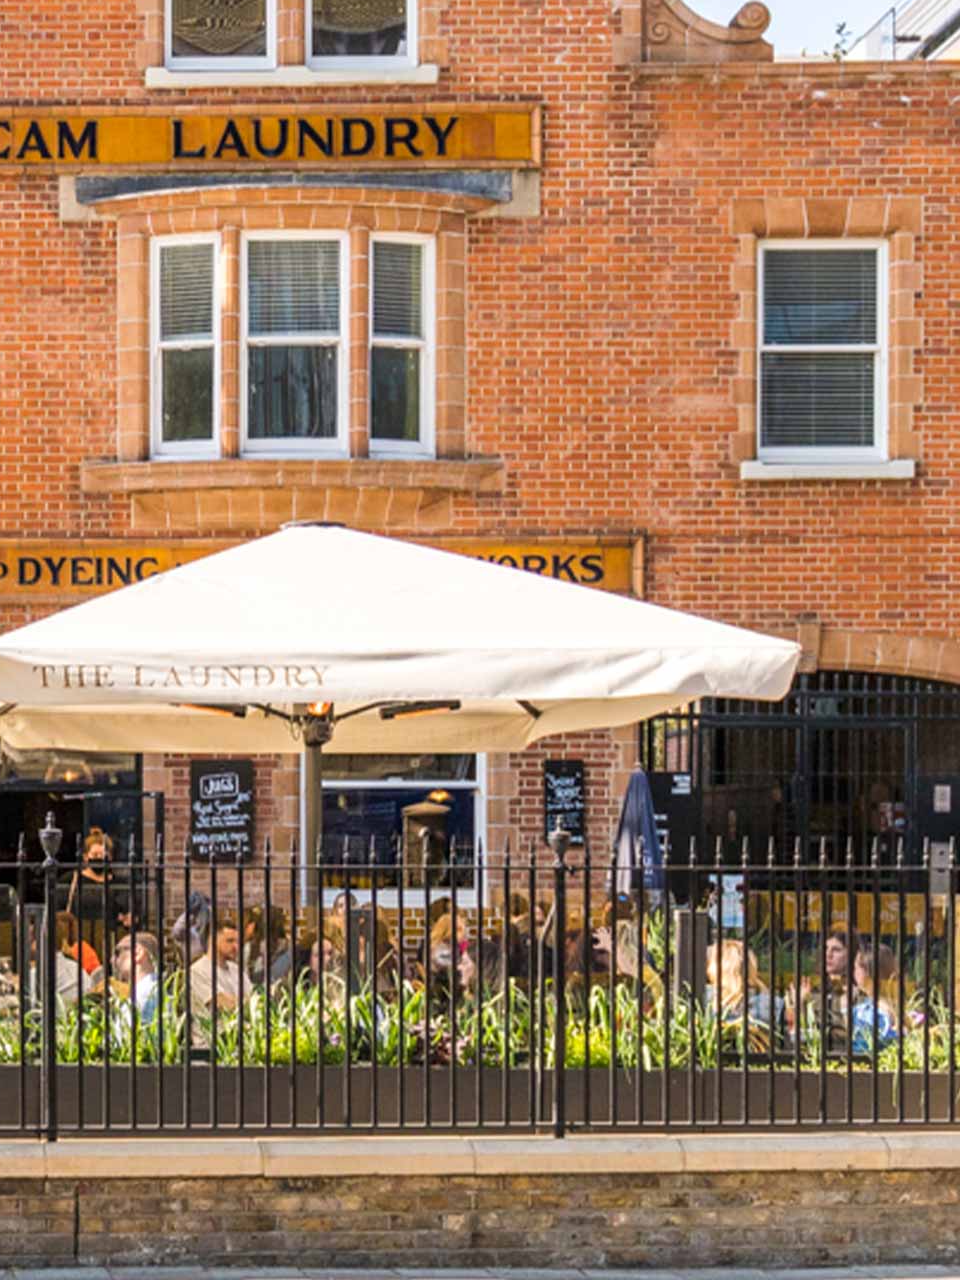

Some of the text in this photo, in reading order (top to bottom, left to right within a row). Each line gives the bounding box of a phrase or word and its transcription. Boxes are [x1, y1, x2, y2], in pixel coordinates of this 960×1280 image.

[172, 116, 459, 158] LAUNDRY
[17, 556, 159, 586] DYEING
[32, 663, 329, 688] THE LAUNDRY
